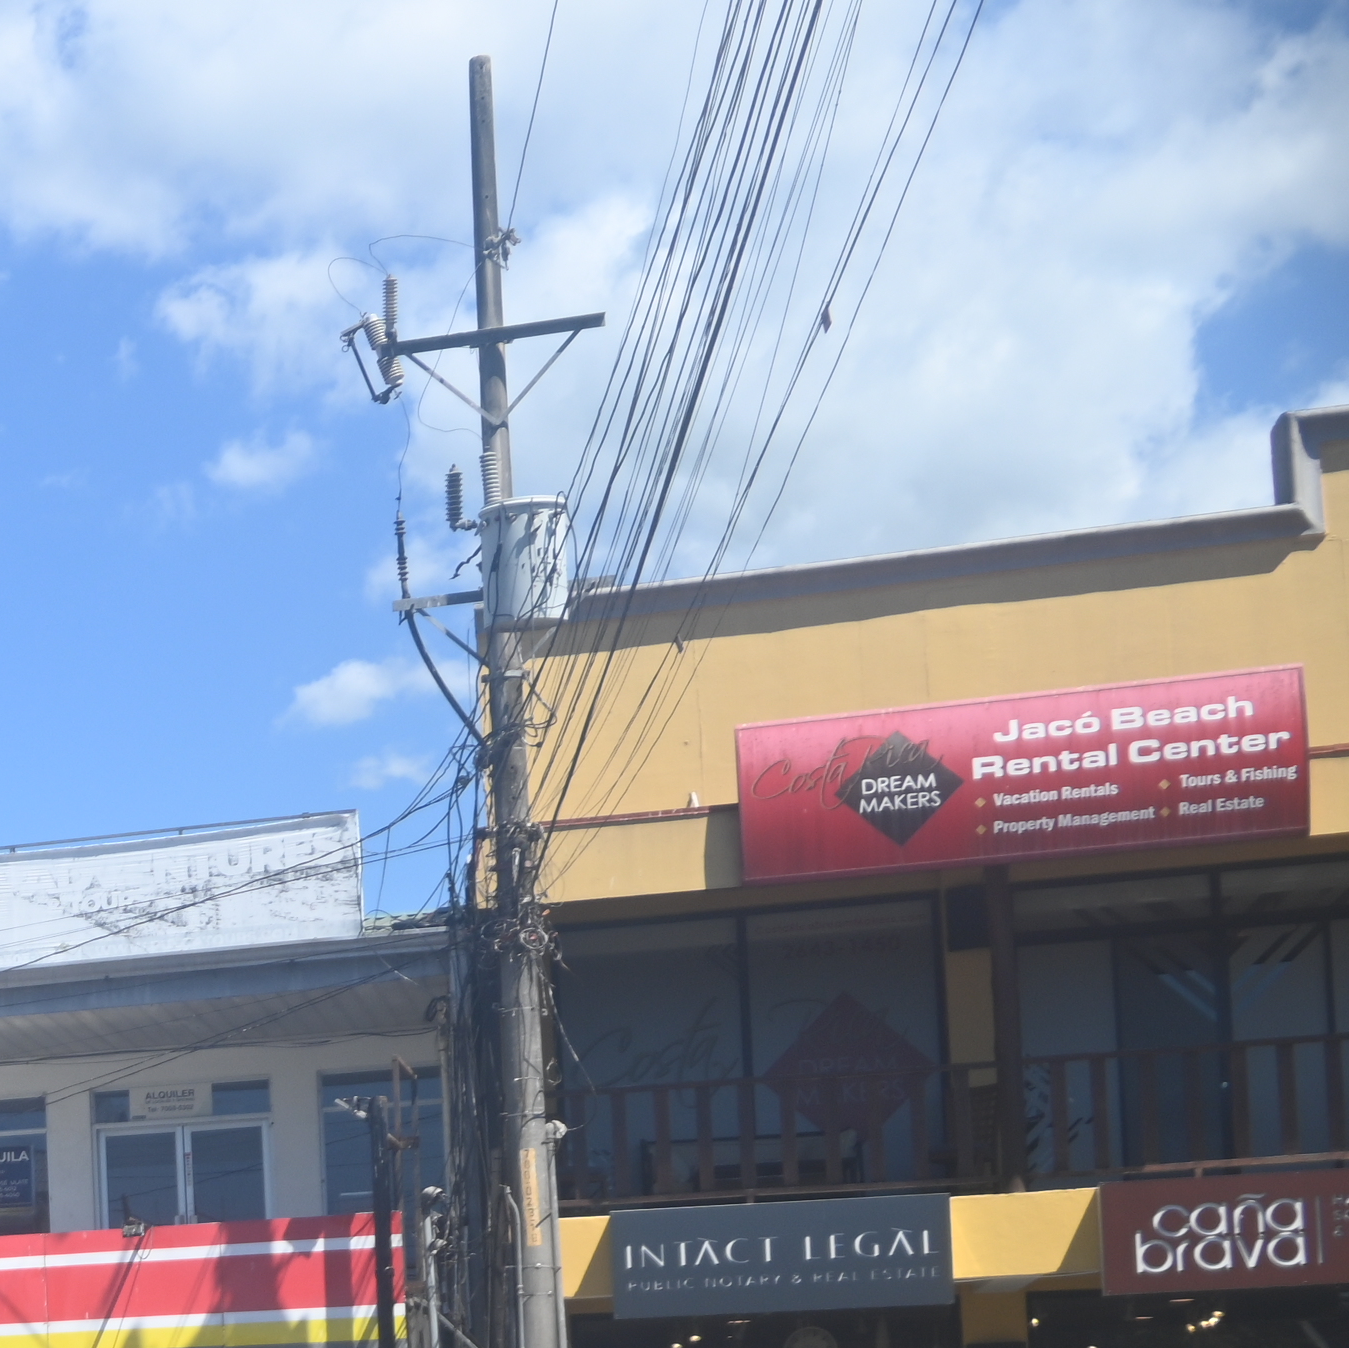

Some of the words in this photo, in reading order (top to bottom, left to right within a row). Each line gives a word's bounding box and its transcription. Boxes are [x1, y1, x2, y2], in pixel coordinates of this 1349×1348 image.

[992, 710, 1101, 742] Jacó
[1110, 695, 1254, 731] Beach
[971, 743, 1119, 780] Rental
[1127, 730, 1291, 764] Center
[861, 773, 937, 795] DREAM
[1179, 772, 1222, 788] Tours
[1225, 769, 1239, 785] &
[1241, 764, 1298, 783] Fishing
[859, 790, 941, 814] MAKERS
[993, 787, 1059, 807] Vacation
[1061, 781, 1120, 801] Rentals
[1178, 799, 1213, 816] Real
[1216, 795, 1265, 813] Estate
[993, 815, 1056, 835] Property
[1058, 805, 1156, 829] Management
[145, 1088, 195, 1100] ALQUILER
[1152, 1192, 1306, 1238] caña
[625, 1236, 779, 1270] INTACT
[804, 1227, 941, 1261] LEGAL
[1134, 1230, 1308, 1275] brava
[627, 1276, 695, 1291] PUBLIC
[704, 1274, 781, 1288] NOTARY
[812, 1270, 861, 1283] REAL
[870, 1265, 941, 1281] ESTATE
